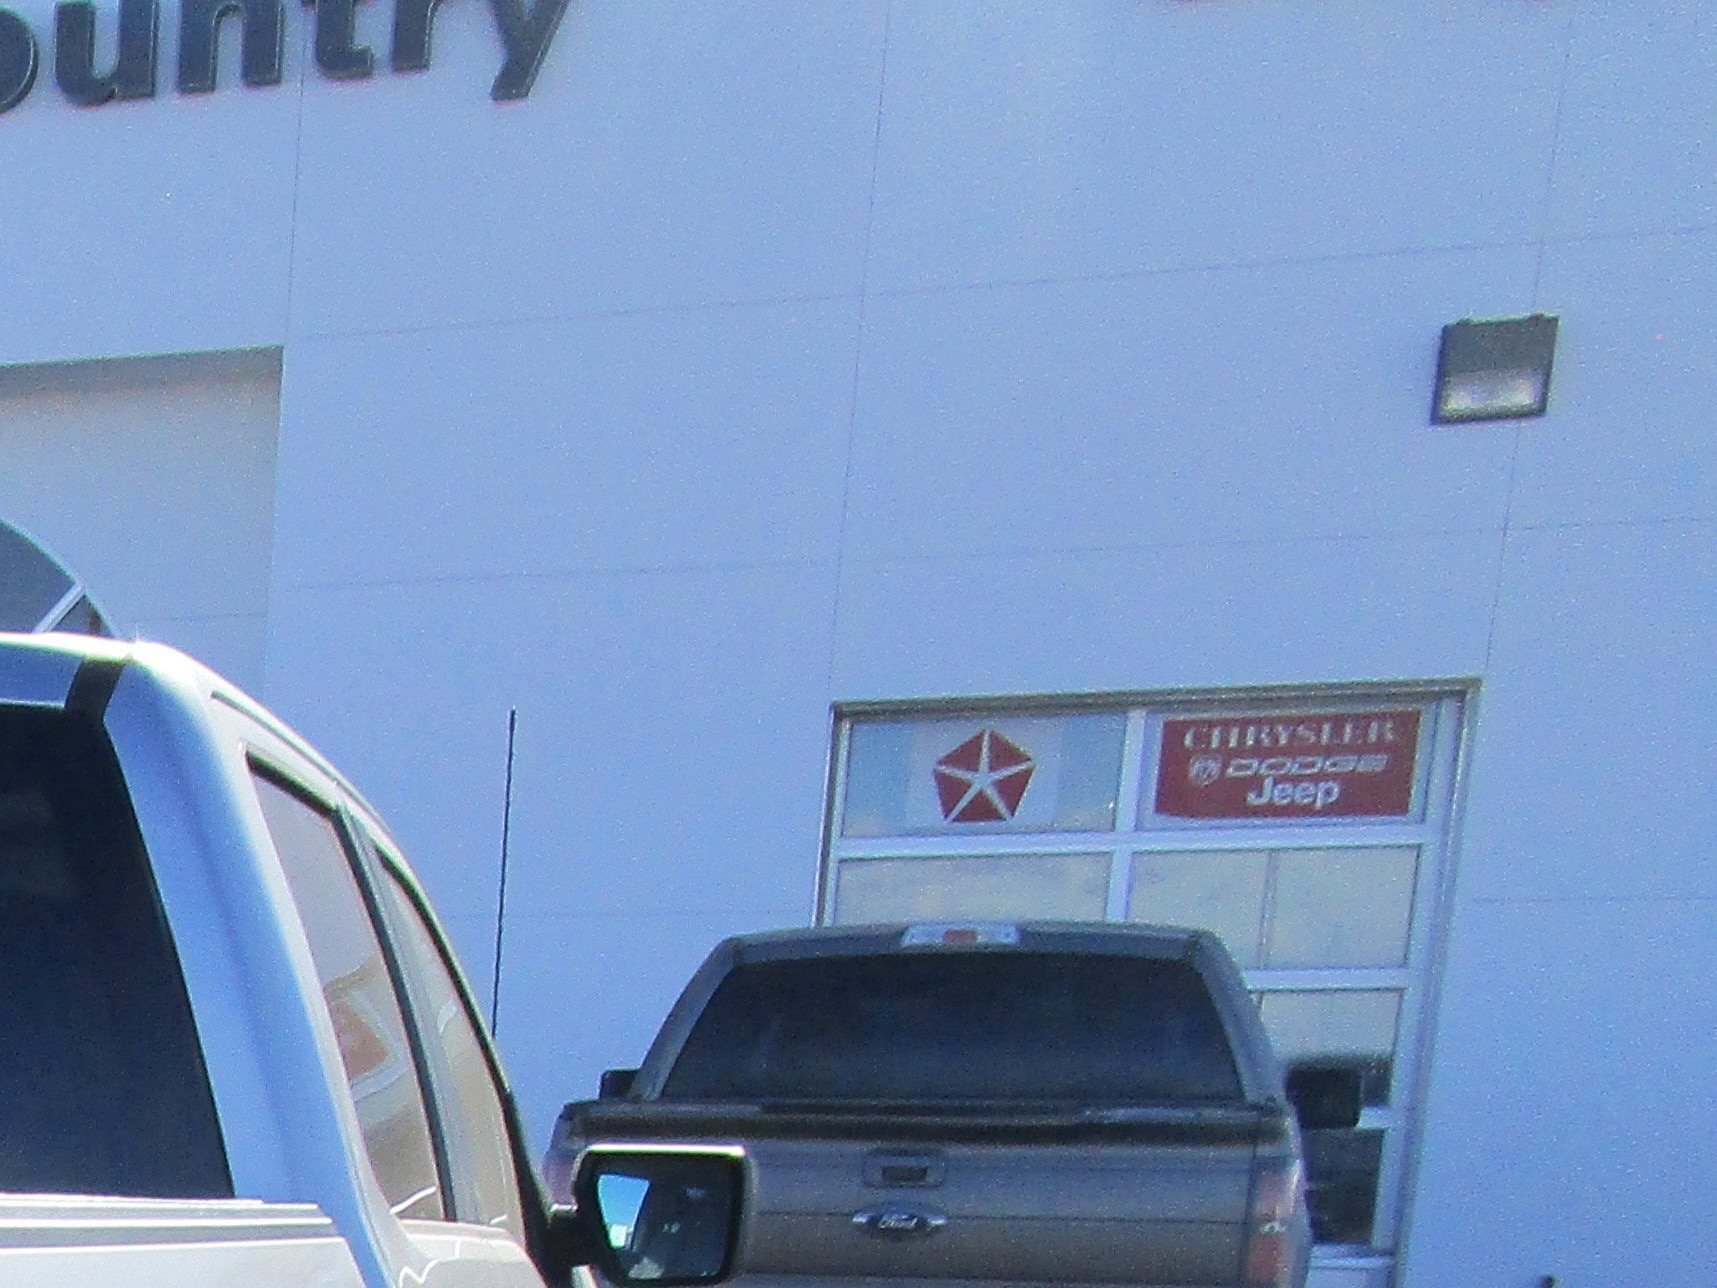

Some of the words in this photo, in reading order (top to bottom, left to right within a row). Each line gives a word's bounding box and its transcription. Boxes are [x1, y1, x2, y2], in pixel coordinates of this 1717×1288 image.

[1183, 720, 1395, 749] CHRYSLER
[1225, 753, 1390, 777] DODGE
[1245, 776, 1341, 810] Jeep
